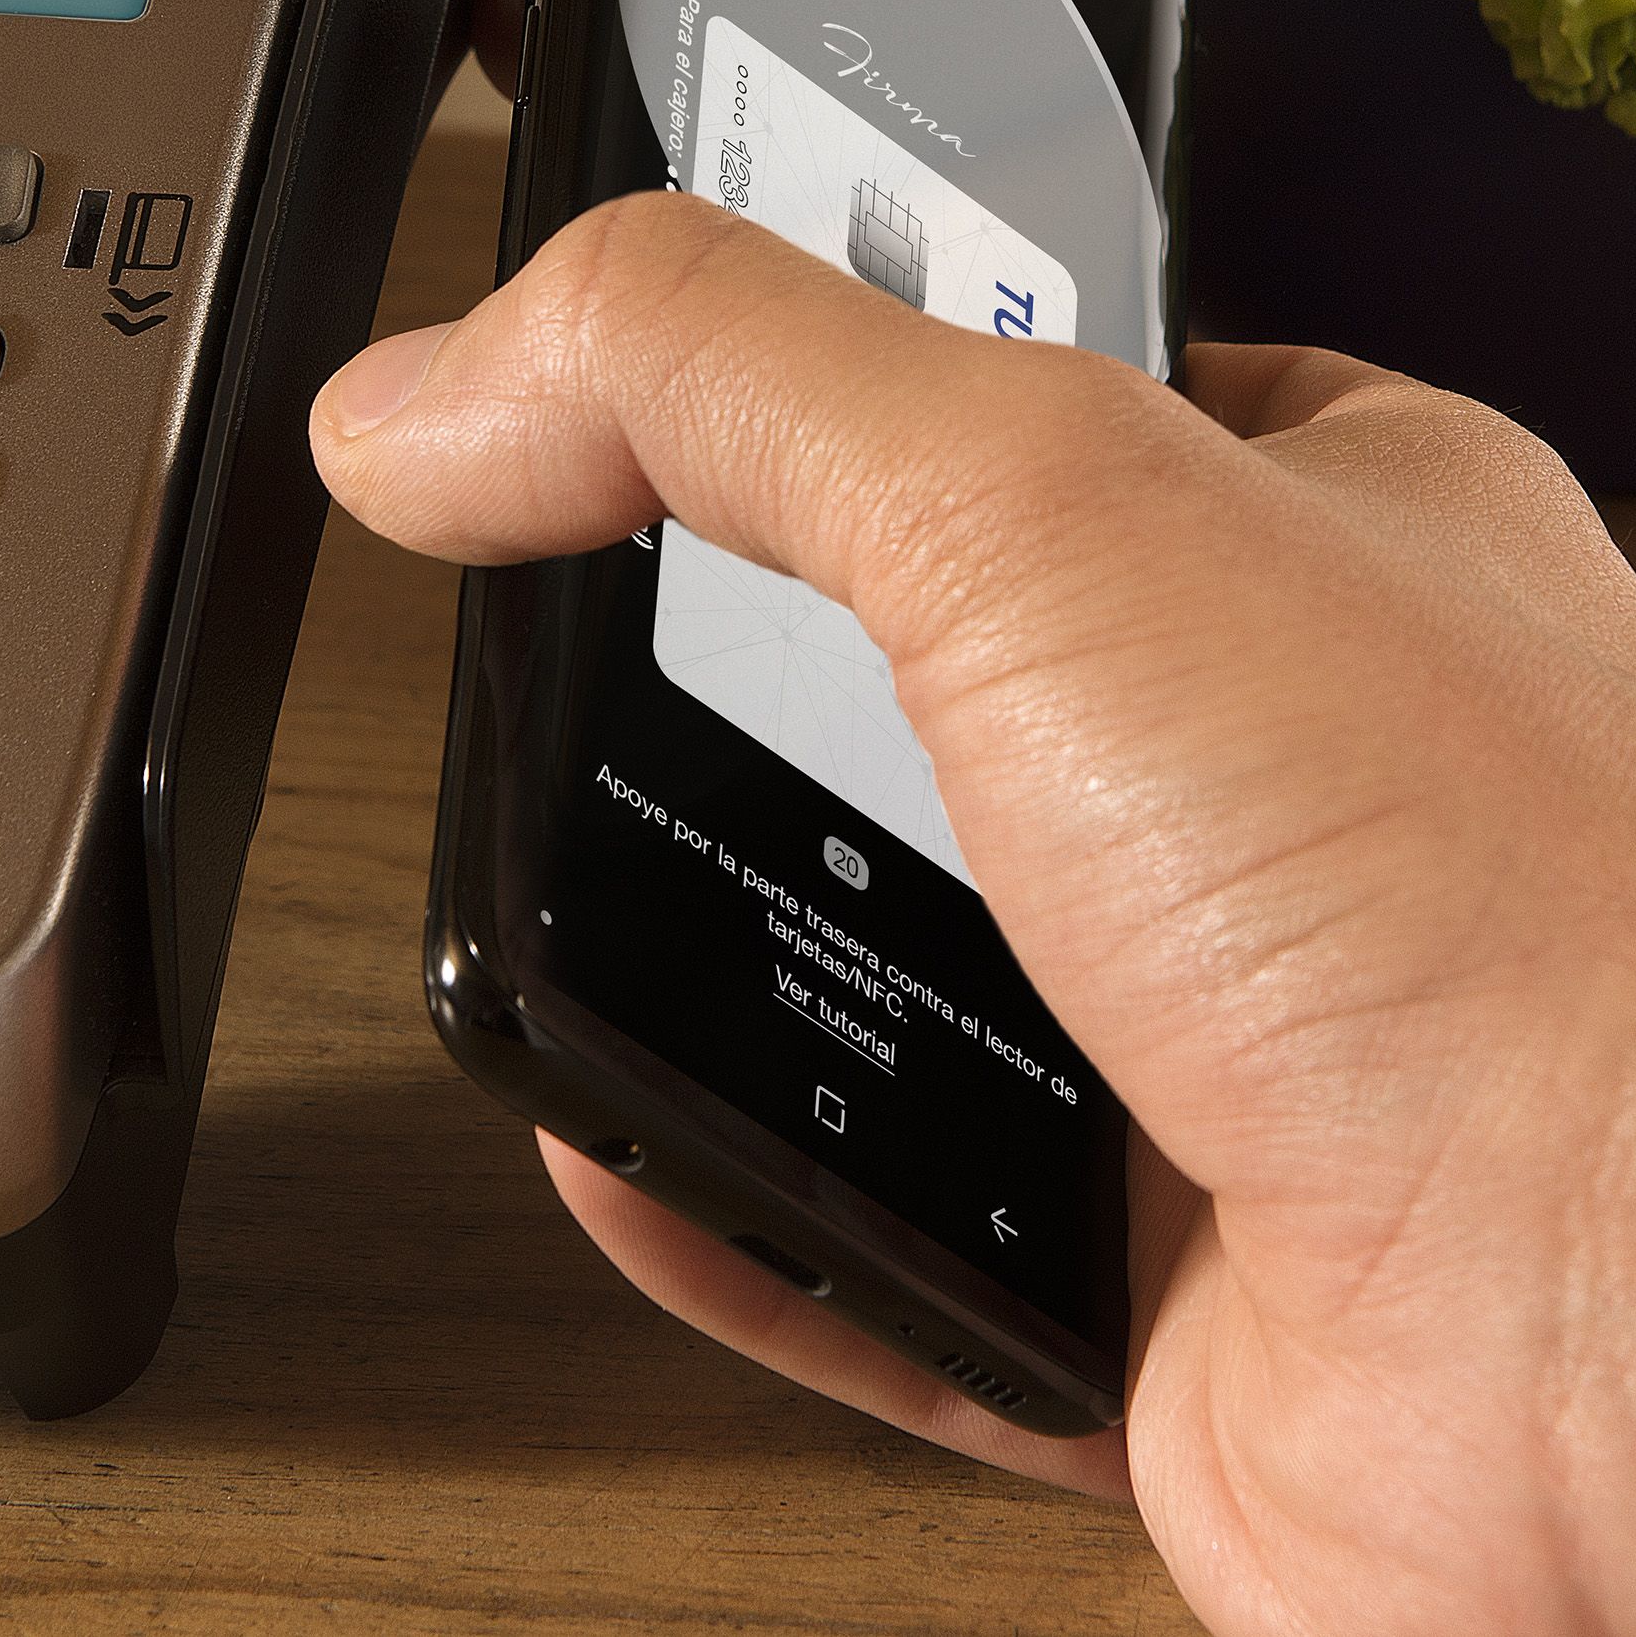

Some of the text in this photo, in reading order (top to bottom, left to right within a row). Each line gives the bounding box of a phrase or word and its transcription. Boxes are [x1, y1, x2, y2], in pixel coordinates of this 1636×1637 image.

[676, 51, 694, 80] el
[821, 22, 977, 158] Firma
[667, 78, 691, 159] cajero:
[833, 846, 859, 879] 20
[596, 764, 1078, 1105] Apoye por la parte trasera contra el lector de
[767, 910, 909, 1024] tarjetas/NFC.
[775, 964, 896, 1066] Ver tutorial
